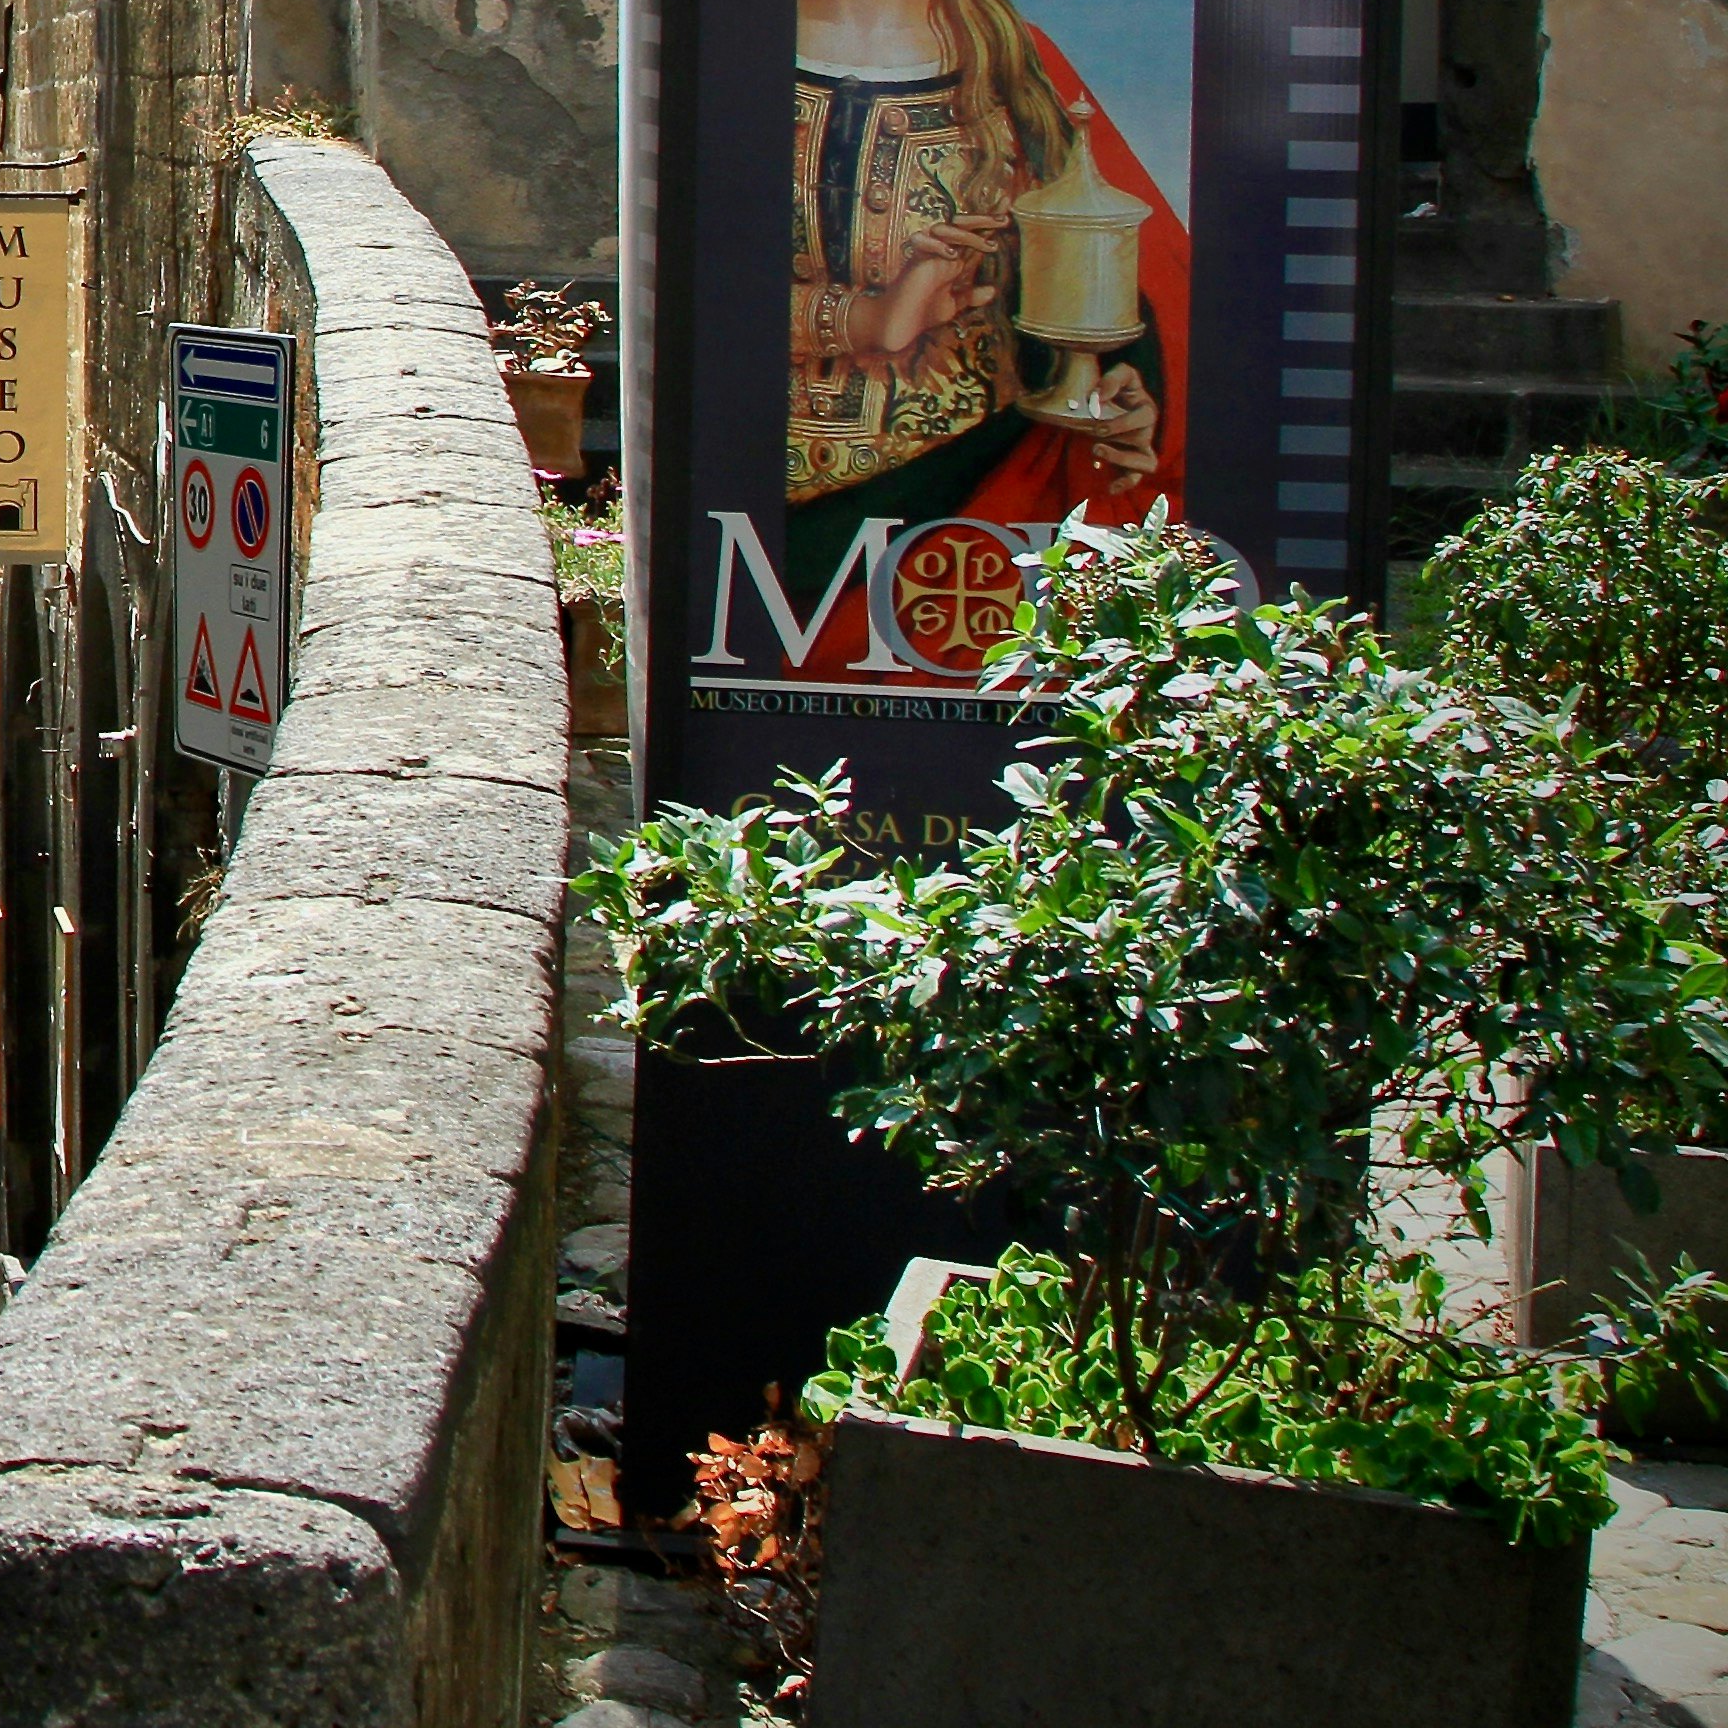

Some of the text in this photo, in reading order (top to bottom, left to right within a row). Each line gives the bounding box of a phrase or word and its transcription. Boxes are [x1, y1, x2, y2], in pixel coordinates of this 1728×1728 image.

[260, 419, 269, 450] 6
[188, 483, 209, 525] 30
[690, 690, 1064, 725] MUSEO DELL'OPERA DEL DUO
